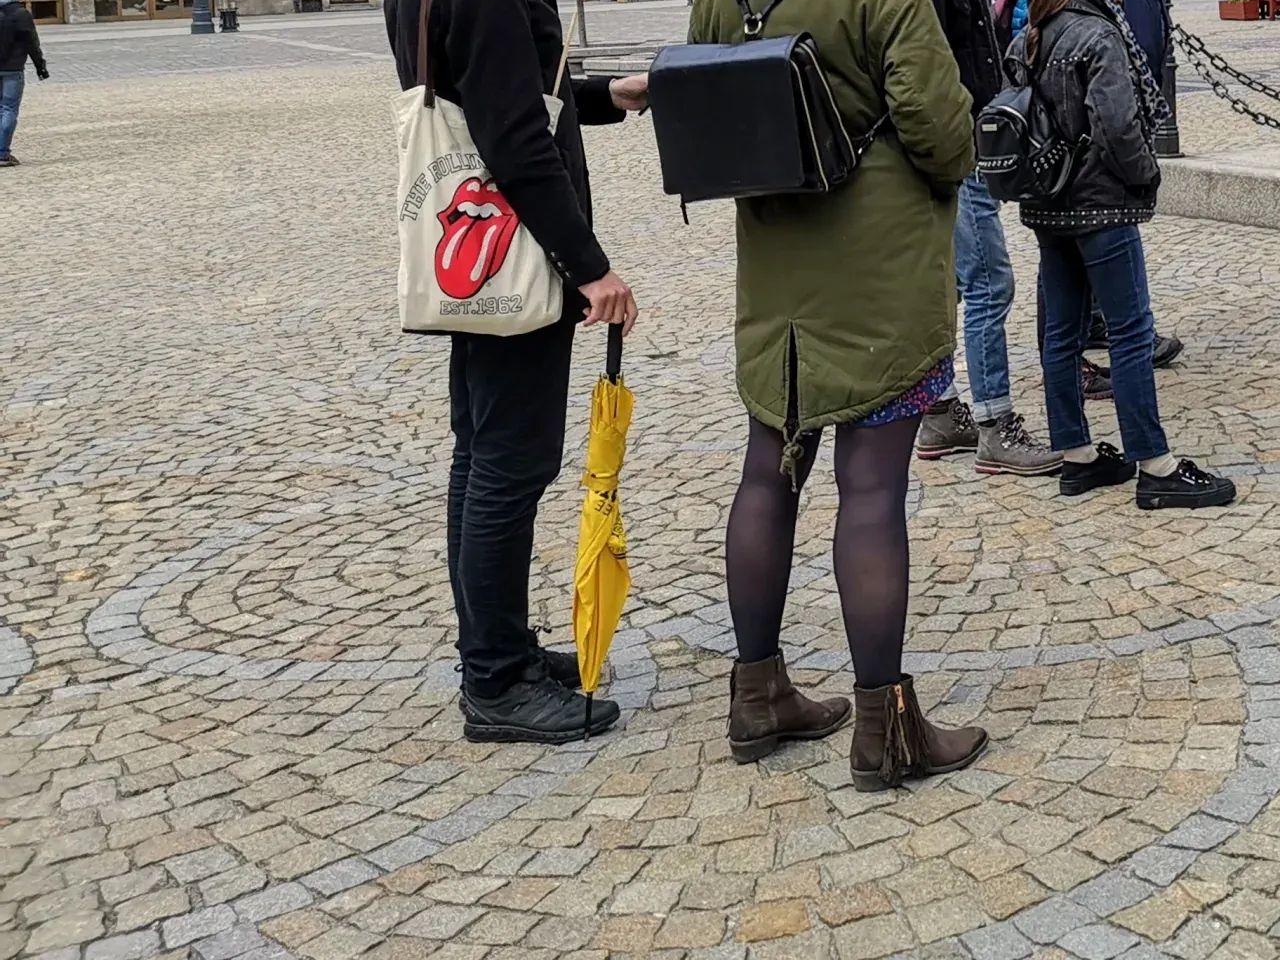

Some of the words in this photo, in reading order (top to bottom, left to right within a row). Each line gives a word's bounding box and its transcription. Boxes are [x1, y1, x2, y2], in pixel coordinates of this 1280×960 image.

[400, 172, 432, 221] THE
[427, 152, 487, 184] ROLLIN
[440, 294, 523, 315] EST.1962
